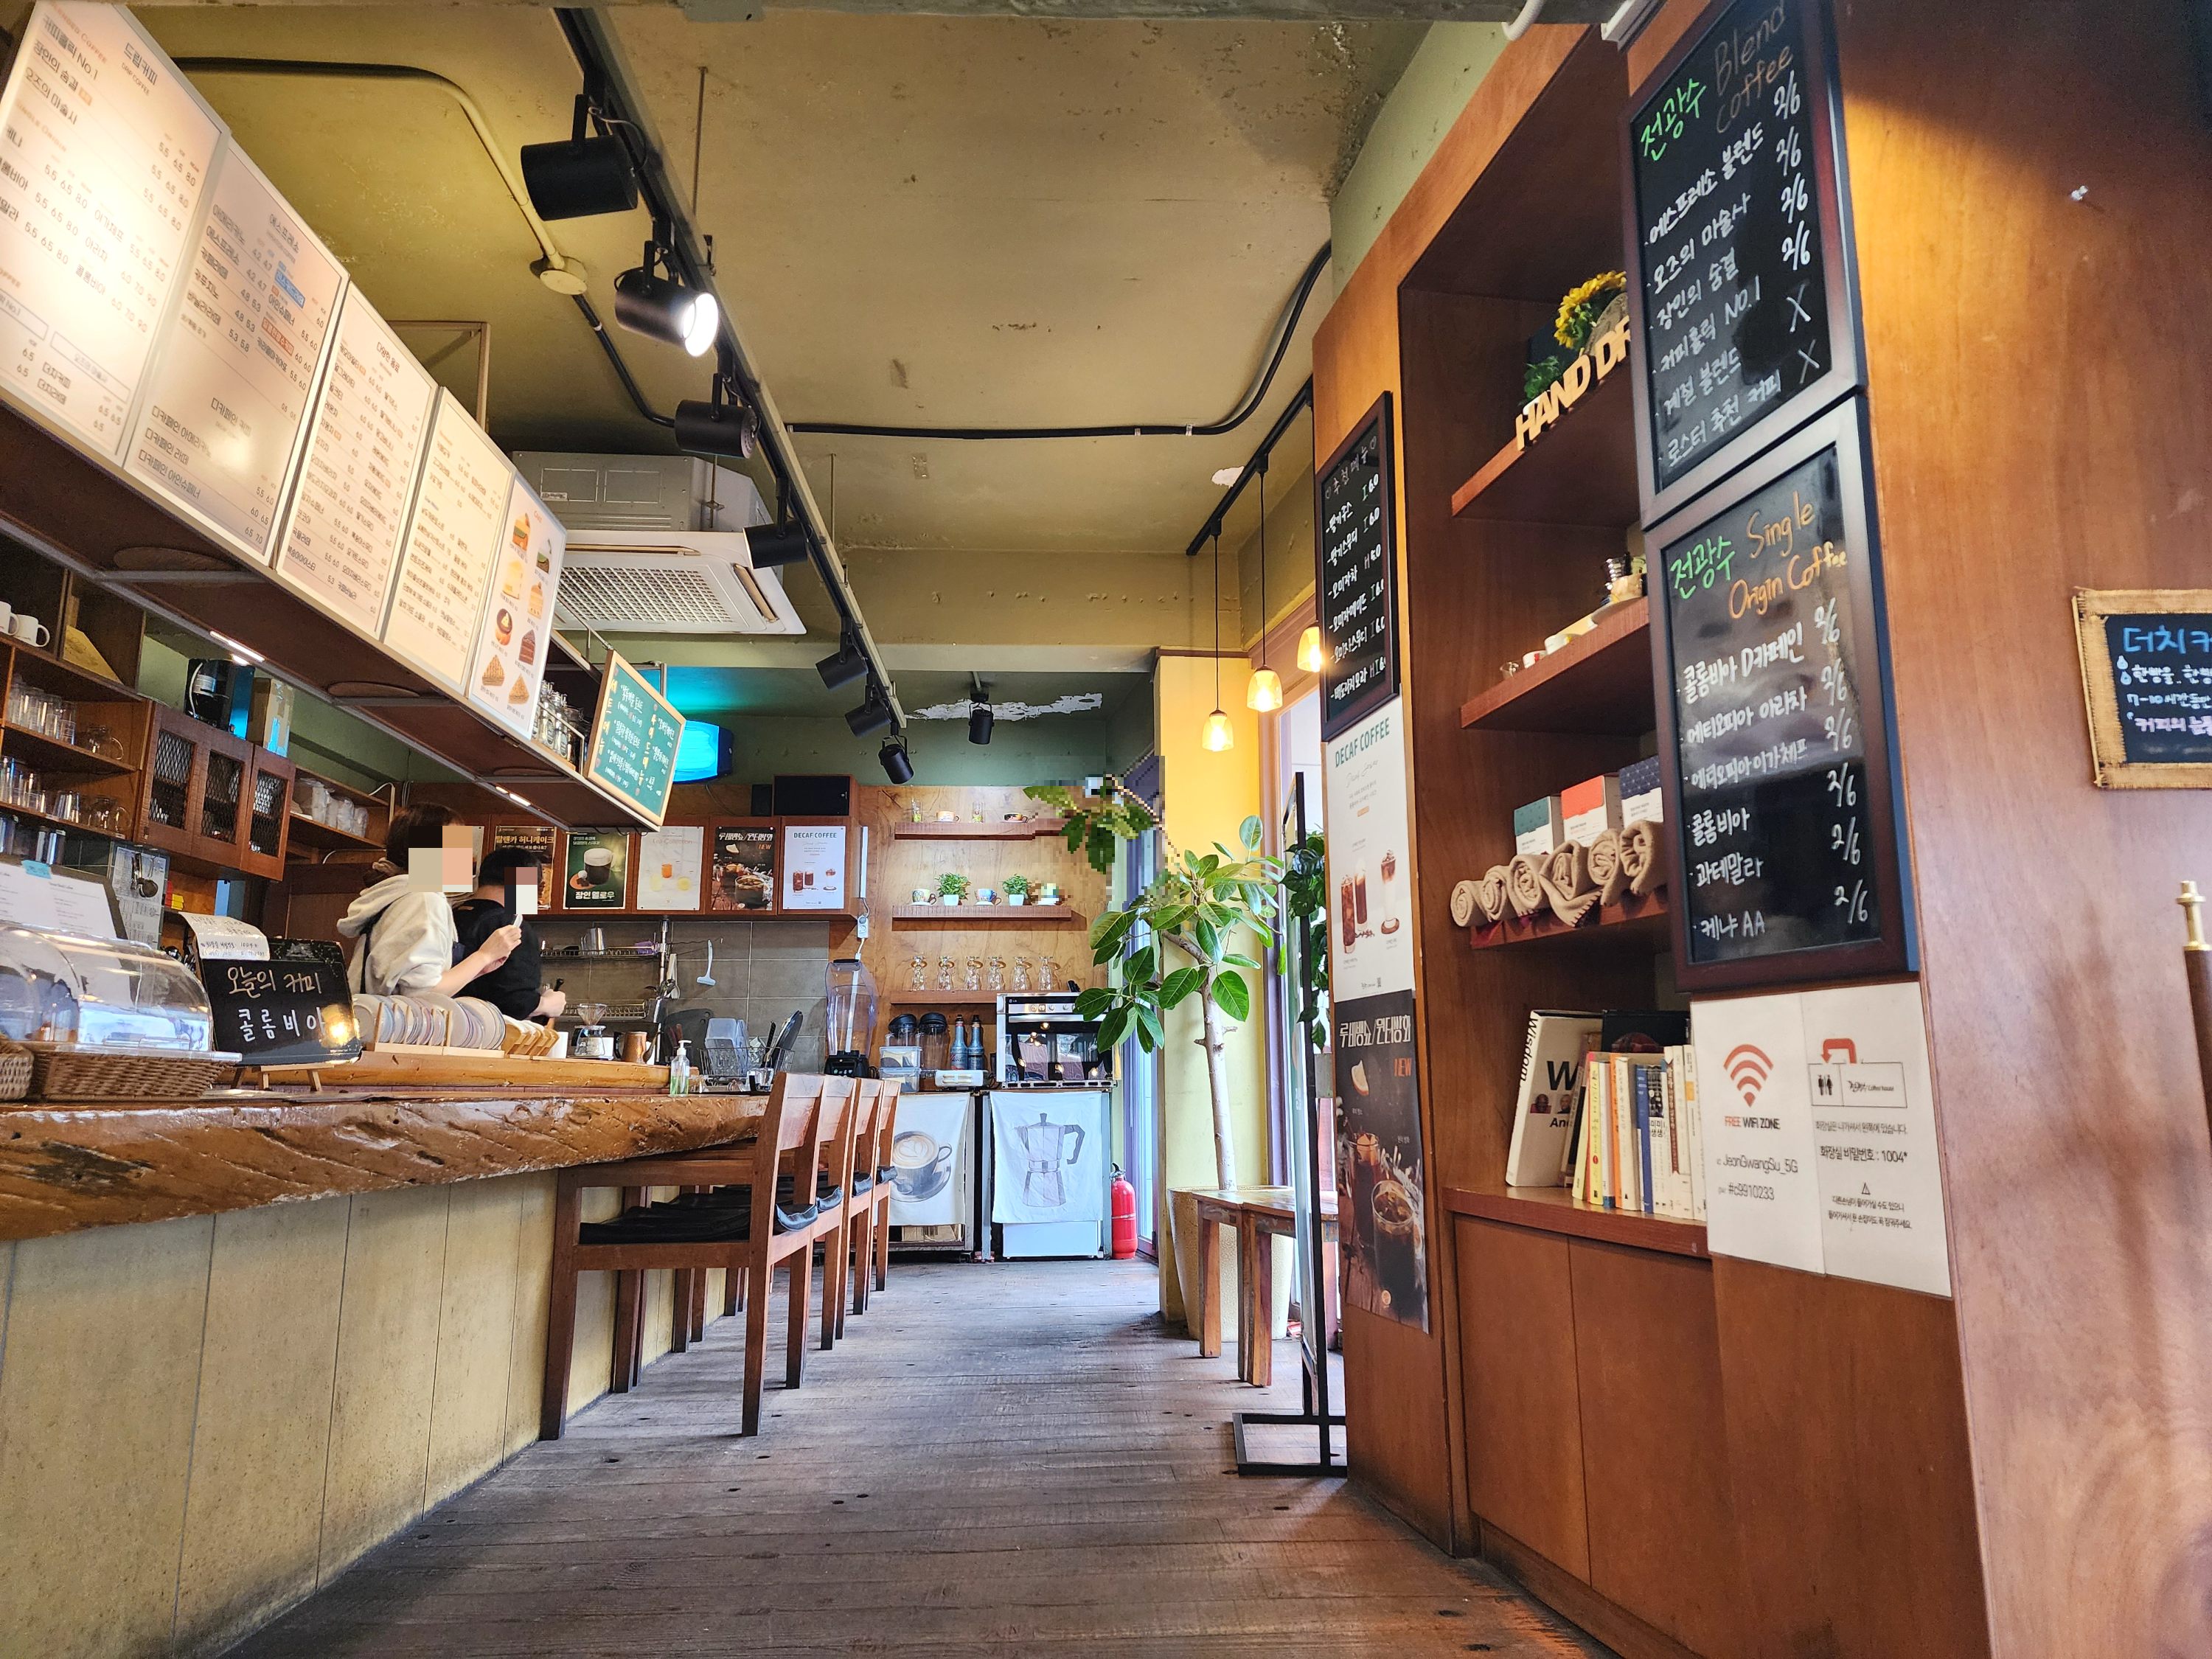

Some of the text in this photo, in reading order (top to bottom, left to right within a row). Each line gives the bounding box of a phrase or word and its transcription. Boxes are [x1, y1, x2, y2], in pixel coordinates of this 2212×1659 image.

[32, 38, 60, 74] 장인의
[59, 66, 79, 94] 숨결
[123, 40, 158, 87] 드립커피
[1715, 0, 1784, 97] Blend
[24, 65, 51, 100] 오즈의
[50, 91, 77, 126] 마술사
[41, 13, 196, 188] 커피홀릭 No.1 5.5 6.5 8.0
[132, 73, 150, 97] COFFEE
[1641, 77, 1707, 161] 전광수
[1649, 70, 1801, 244] 에스프레소 블렌드 2/6
[44, 162, 58, 181] 5.5
[59, 177, 73, 195] 6.5
[74, 191, 88, 209] 8.0
[1654, 126, 1801, 294] 오즈의 마술사 2/6
[205, 223, 240, 267] 에스프레소
[268, 210, 300, 254] 에스프레소
[1657, 173, 1808, 330] 장인의 숨결 2/6
[74, 263, 106, 297] 콜롬비아
[193, 268, 220, 300] 카푸치노
[1660, 313, 1716, 372] 커피홀릭
[1781, 220, 1810, 270] 2/6
[268, 292, 295, 327] 아인슈페너
[309, 338, 317, 352] 6.0
[41, 361, 71, 390] 더치커피
[376, 341, 391, 362] 다양한
[1515, 354, 1590, 451] HAND
[1663, 375, 1697, 415] 계절
[1700, 347, 1742, 396] 블렌드
[150, 404, 181, 434] 디카페인
[210, 396, 251, 437] 디카페인 커피
[1668, 420, 1707, 467] 로스터
[1711, 394, 1742, 432] 추천
[1747, 369, 1781, 403] 커피
[137, 448, 201, 499] 디카페인 아인슈페너
[144, 426, 174, 455] 디카페인
[250, 506, 259, 518] 6.0
[260, 514, 268, 526] 6.5
[1329, 501, 1353, 533] 딸기주스
[1368, 473, 1379, 493] 6.0
[1747, 491, 1815, 558] Single
[1330, 527, 1357, 566] 딸기스무디
[1369, 507, 1380, 526] 6.0
[1332, 565, 1358, 599] 오미자차
[1371, 543, 1381, 561] 5.0
[1670, 536, 1735, 599] 전광수
[1729, 576, 1784, 619] Origin
[1333, 593, 1367, 633] 오미자에이드
[1334, 627, 1367, 664] 오미자스무디
[1683, 597, 1840, 703] 콜롬비아 D카페인 2/6
[1687, 658, 1847, 743] 에티오피아 아리차 2/6
[2134, 717, 2187, 732] 커피의
[1335, 717, 1390, 768] DECAF COFFEE
[1825, 708, 1851, 751] 2/6
[1691, 762, 1857, 846] 콜롬비아 2/6
[518, 835, 554, 844] 허니케이크
[1697, 817, 1860, 886] 과테말라 2/6
[1700, 880, 1868, 941] 케냐 AA 2/6
[227, 966, 323, 998] 오늘의 커피
[238, 1006, 326, 1043] 콜롬비아
[1520, 1018, 1539, 1082] Wisdom
[1394, 1058, 1412, 1077] NEW
[1725, 1116, 1742, 1127] FREE
[1760, 1118, 1781, 1130] ZONE
[1723, 1154, 1798, 1174] JeonGwangSu_5G
[1820, 1146, 1842, 1160] 화장실
